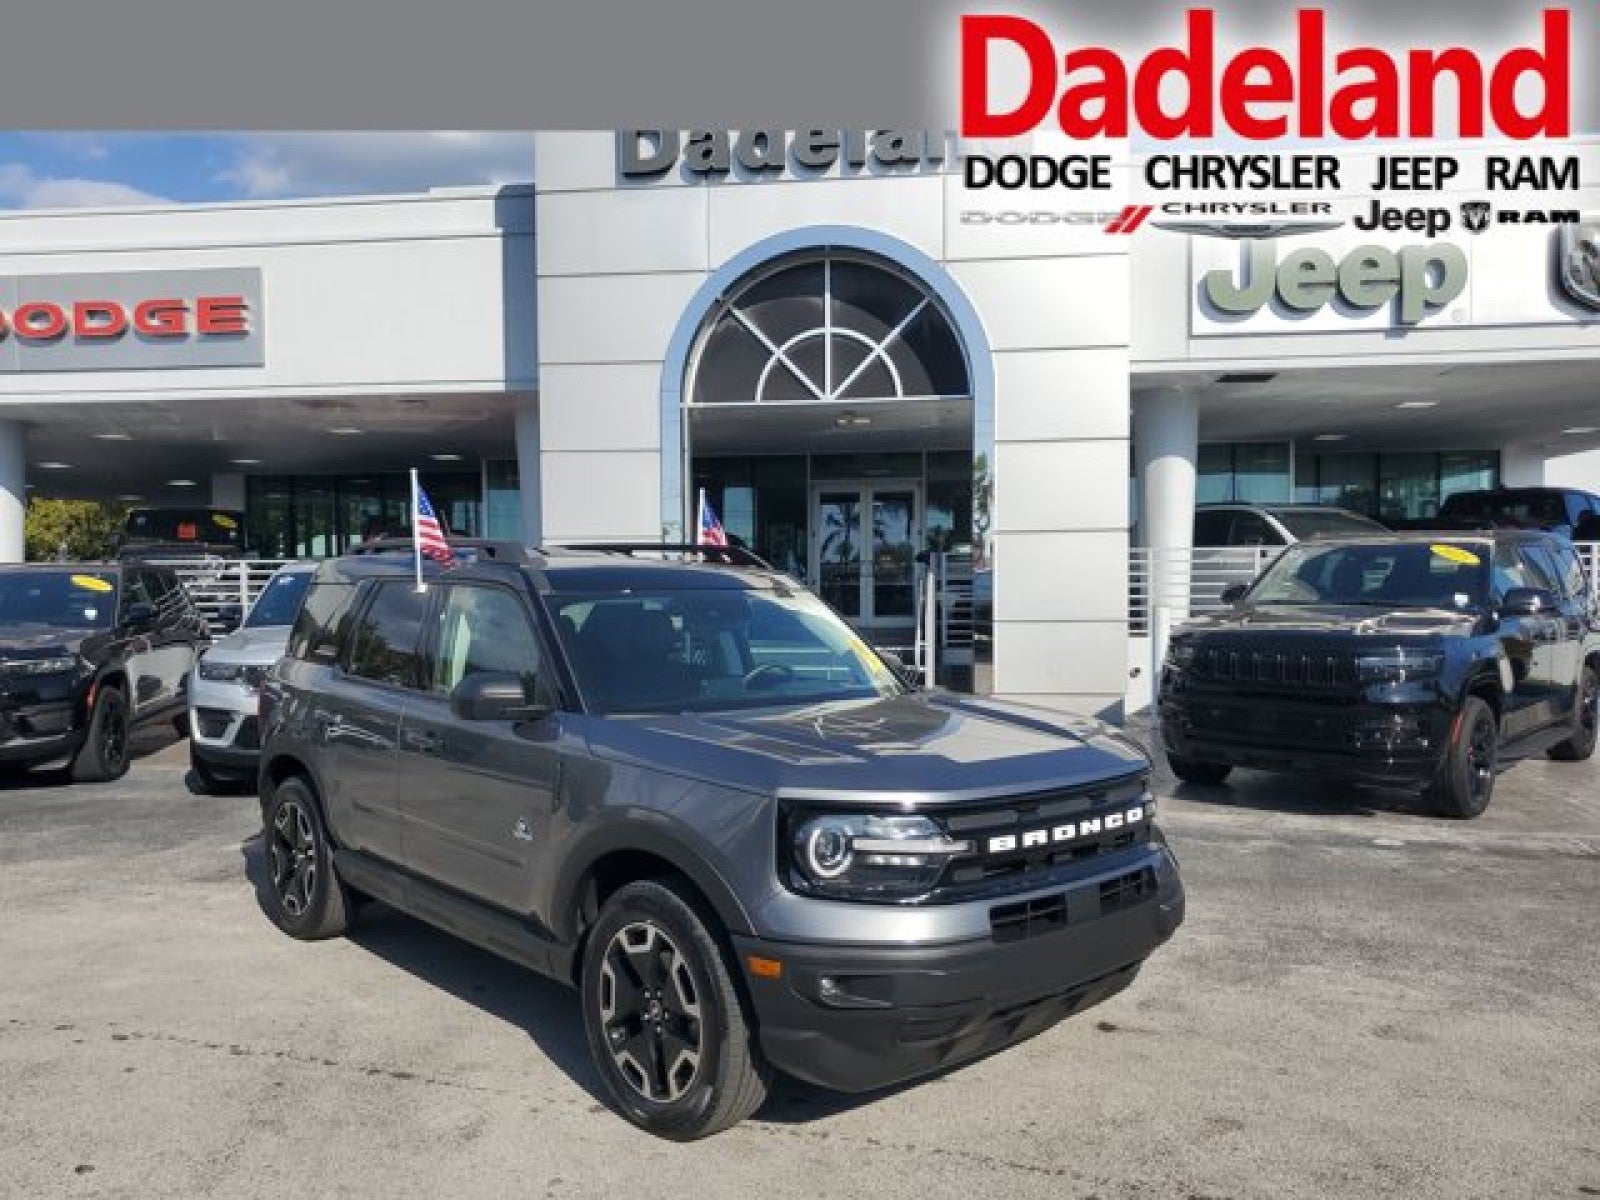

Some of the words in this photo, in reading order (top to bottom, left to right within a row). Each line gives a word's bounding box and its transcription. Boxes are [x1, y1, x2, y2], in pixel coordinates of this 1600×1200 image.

[1204, 238, 1468, 325] Jeep
[0, 296, 248, 340] ODGE
[988, 806, 1144, 854] BRONCO
